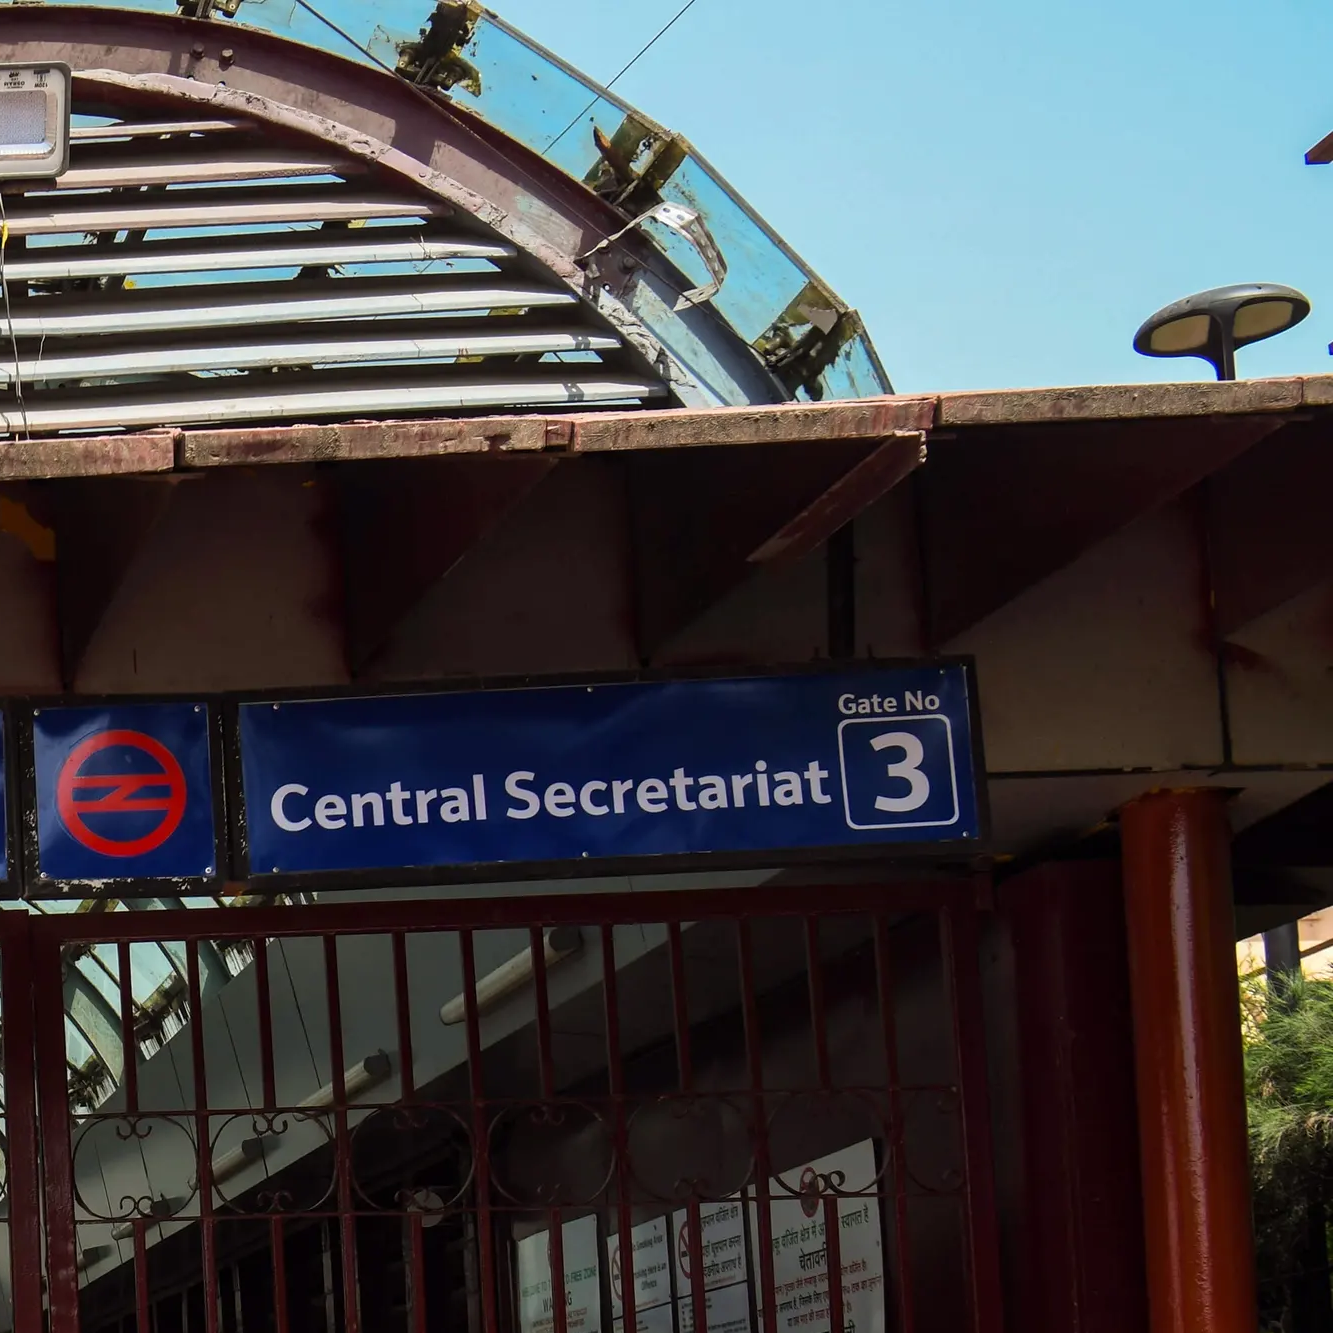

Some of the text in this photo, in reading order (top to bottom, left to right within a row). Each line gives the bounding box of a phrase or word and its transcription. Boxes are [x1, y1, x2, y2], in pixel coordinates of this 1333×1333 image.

[838, 691, 940, 714] Gate No
[270, 760, 832, 832] Central Secretariat
[870, 732, 931, 812] 3
